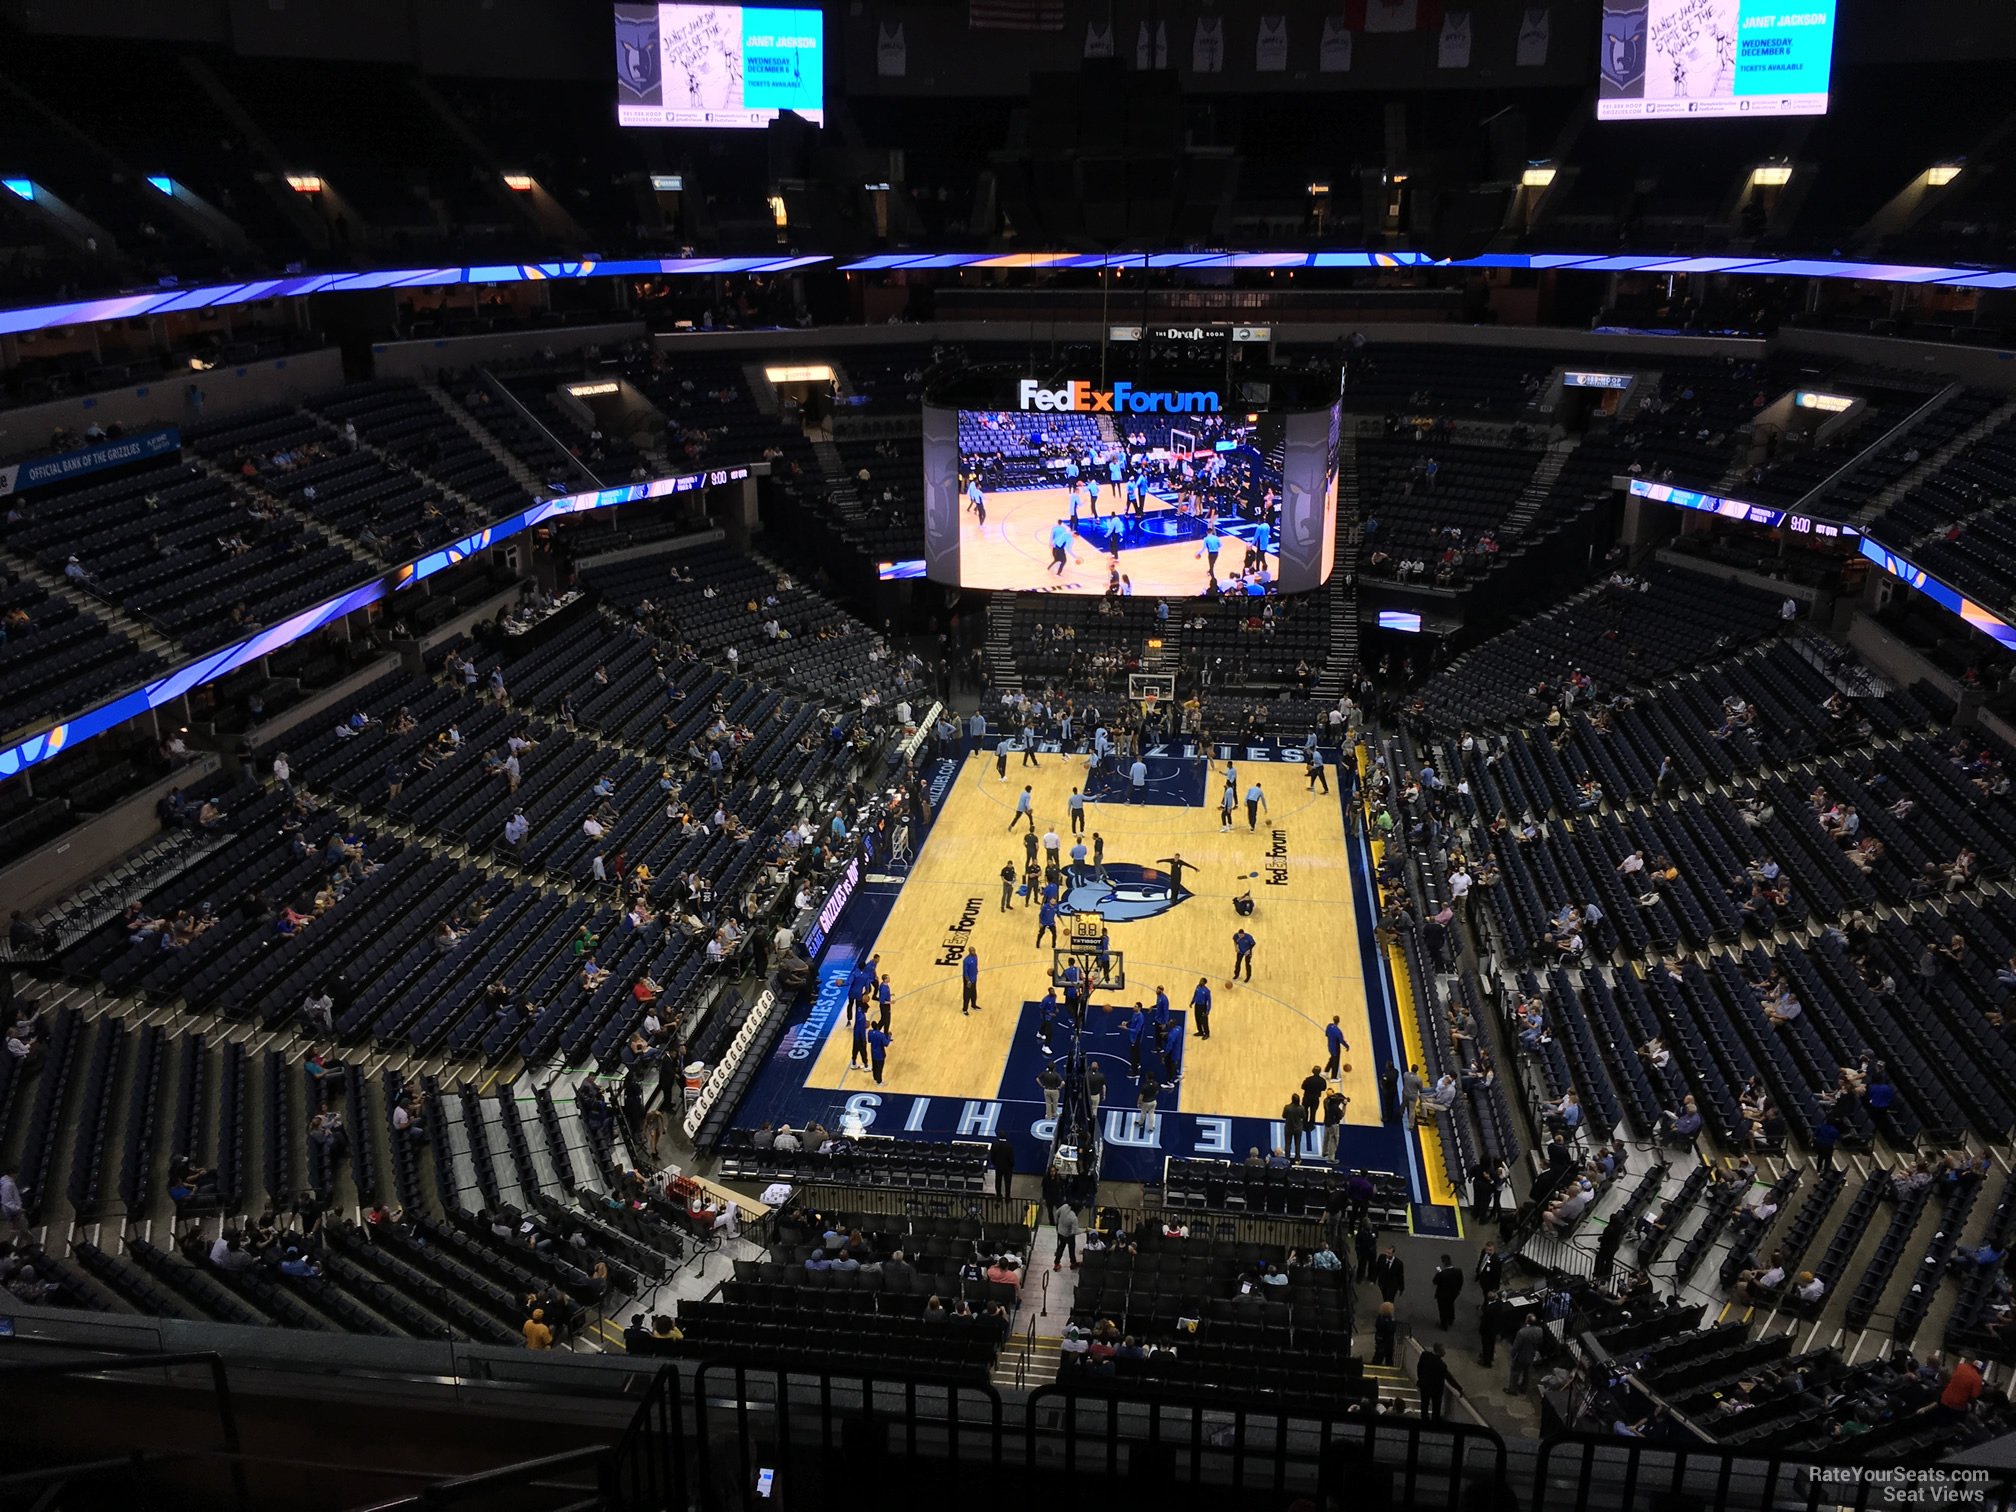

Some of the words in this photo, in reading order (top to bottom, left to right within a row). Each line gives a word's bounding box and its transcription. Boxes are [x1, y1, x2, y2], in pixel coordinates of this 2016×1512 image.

[1694, 5, 1715, 25] THE
[1742, 15, 1776, 29] JANET
[1777, 13, 1827, 27] JACKSON
[1651, 12, 1677, 40] JANET
[664, 27, 688, 51] JANET
[746, 37, 775, 48] JANET
[775, 36, 816, 49] JACKSON
[1741, 48, 1784, 57] DECEMBER
[747, 65, 782, 74] DECEMBER
[1740, 64, 1767, 72] TICKETS
[1767, 63, 1804, 71] AVAILABLE
[748, 80, 770, 88] TICKETS
[1167, 328, 1204, 341] Draft
[1020, 379, 1218, 412] FedExForum
[29, 463, 62, 480] OFFICIAL
[63, 457, 82, 472] BANK
[82, 455, 93, 467] OF
[93, 450, 107, 464] THE
[107, 443, 141, 460] GRIZZLIES
[711, 471, 727, 485] 9:00
[1790, 515, 1811, 534] 9:00
[1265, 829, 1288, 886] FedExForum
[819, 884, 847, 934] GRIZZLIES
[935, 897, 984, 967] FedExForum
[788, 969, 851, 1060] GRIZZLIES.COM
